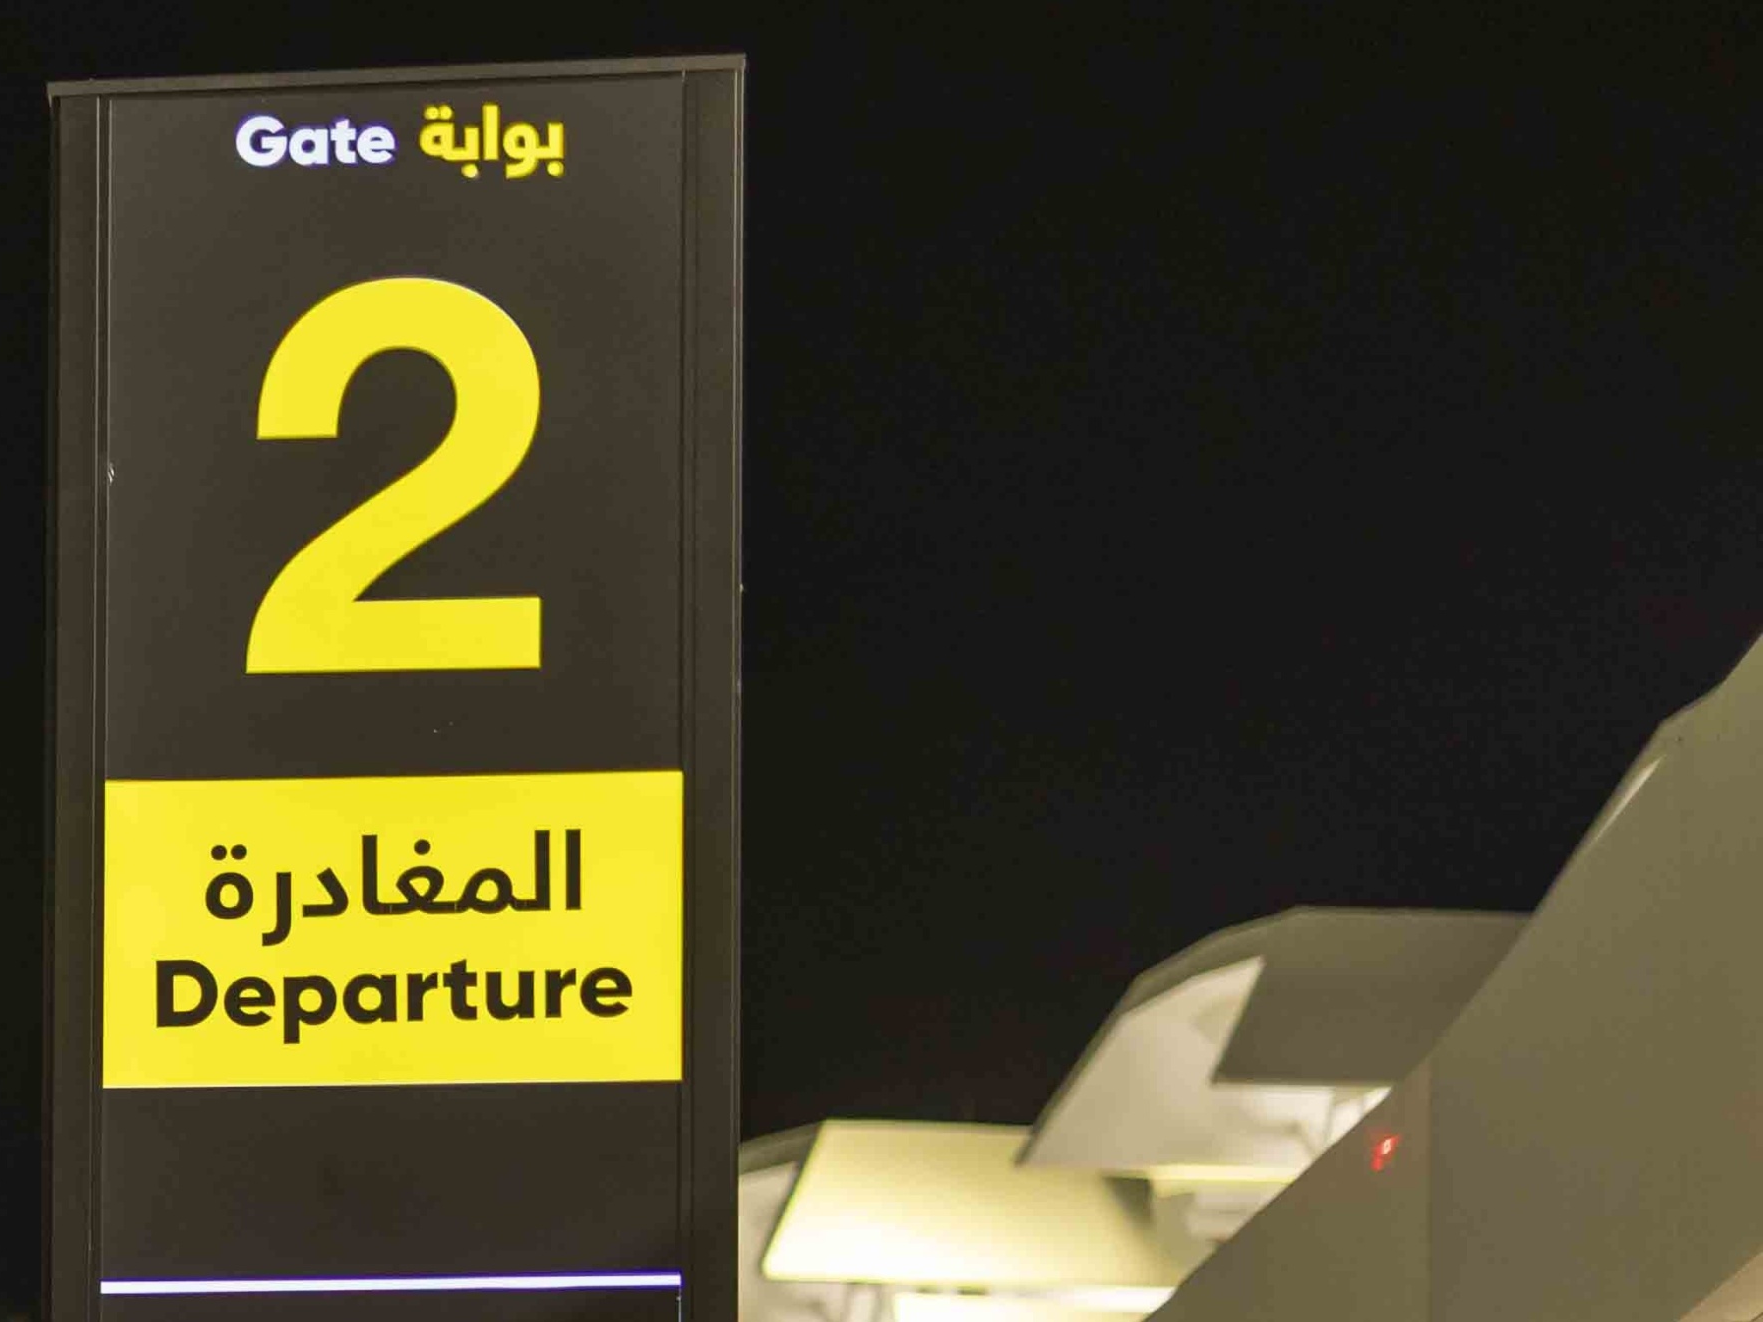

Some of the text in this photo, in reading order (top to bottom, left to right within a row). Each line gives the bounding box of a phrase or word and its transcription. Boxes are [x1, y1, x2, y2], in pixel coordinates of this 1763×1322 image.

[234, 114, 396, 169] Gate
[418, 103, 566, 179] بوابة
[244, 276, 543, 675] 2
[205, 829, 583, 947] المغادرة
[155, 959, 633, 1045] Departure
